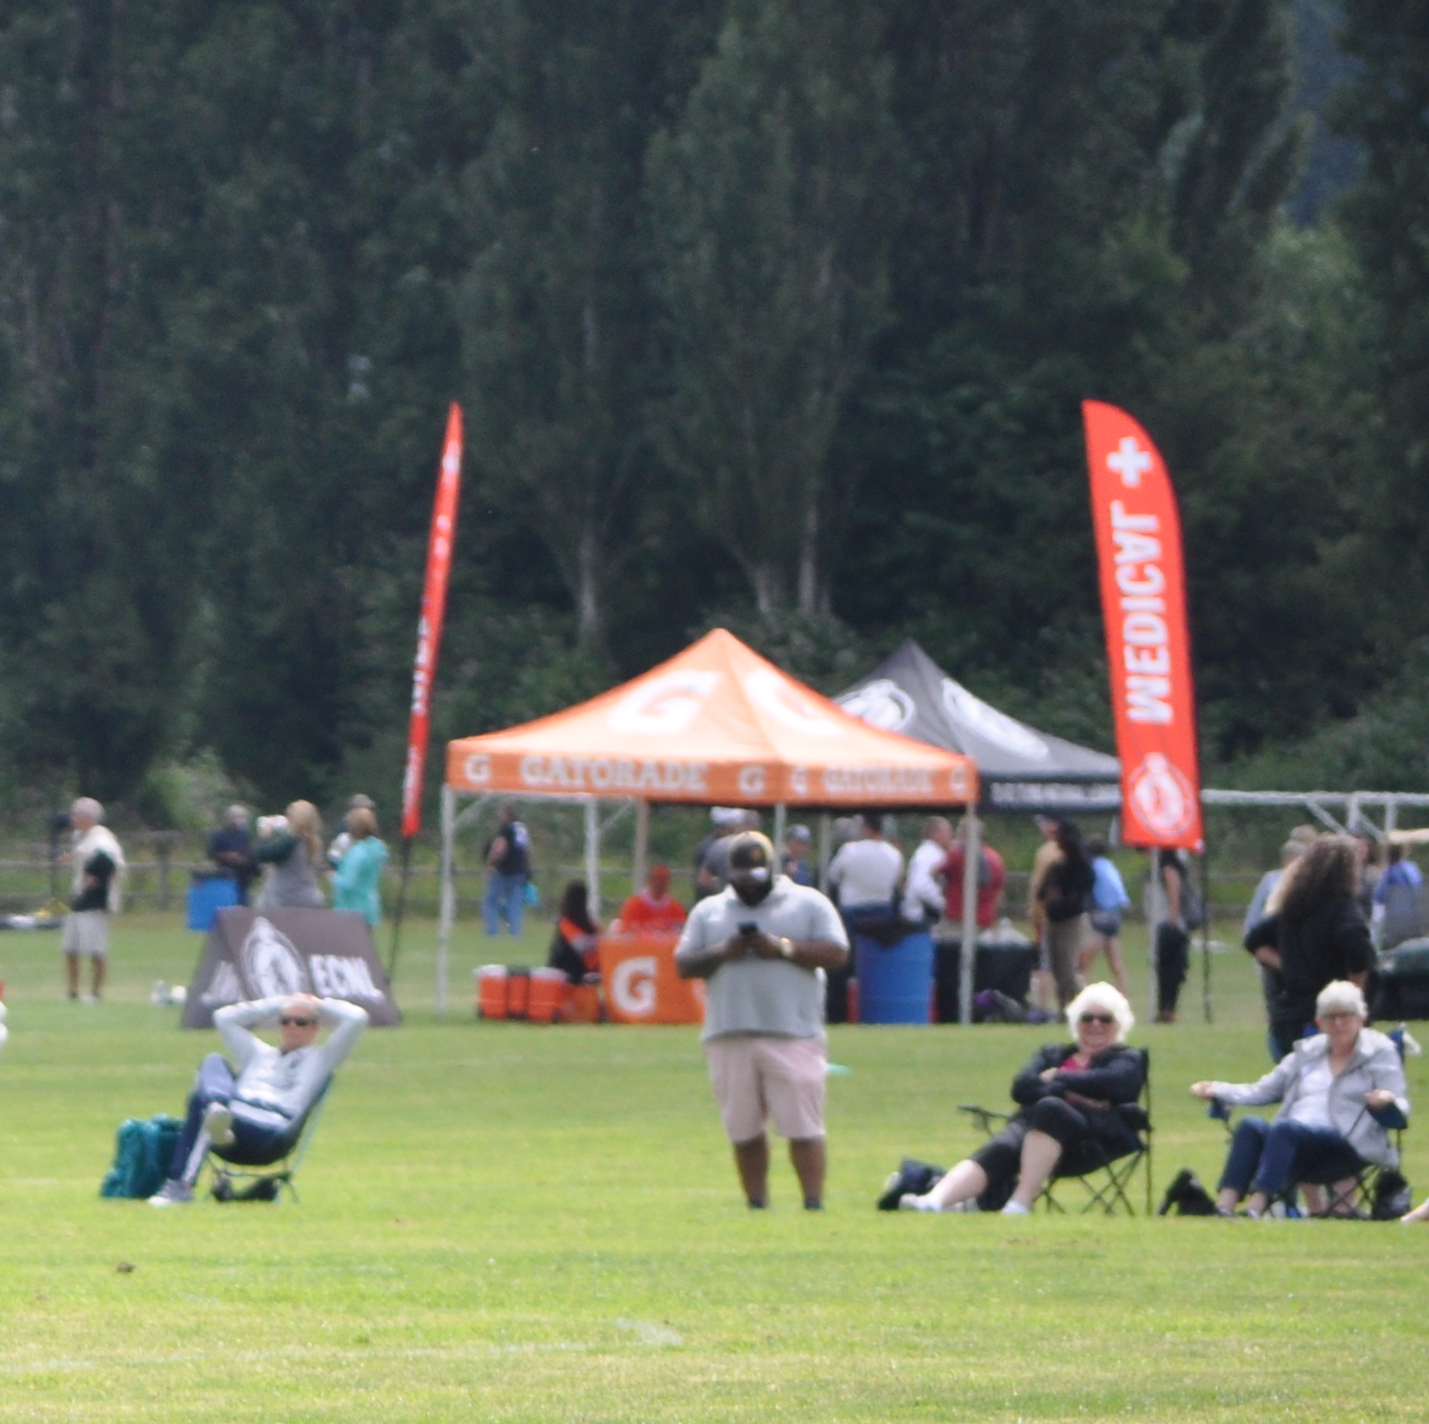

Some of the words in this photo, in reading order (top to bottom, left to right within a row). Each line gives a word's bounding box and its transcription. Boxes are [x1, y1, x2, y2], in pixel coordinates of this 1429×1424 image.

[1110, 500, 1174, 724] MEDICAL
[463, 753, 490, 784] G
[519, 754, 710, 791] GATORADE
[736, 763, 767, 798] G
[611, 955, 658, 1016] G
